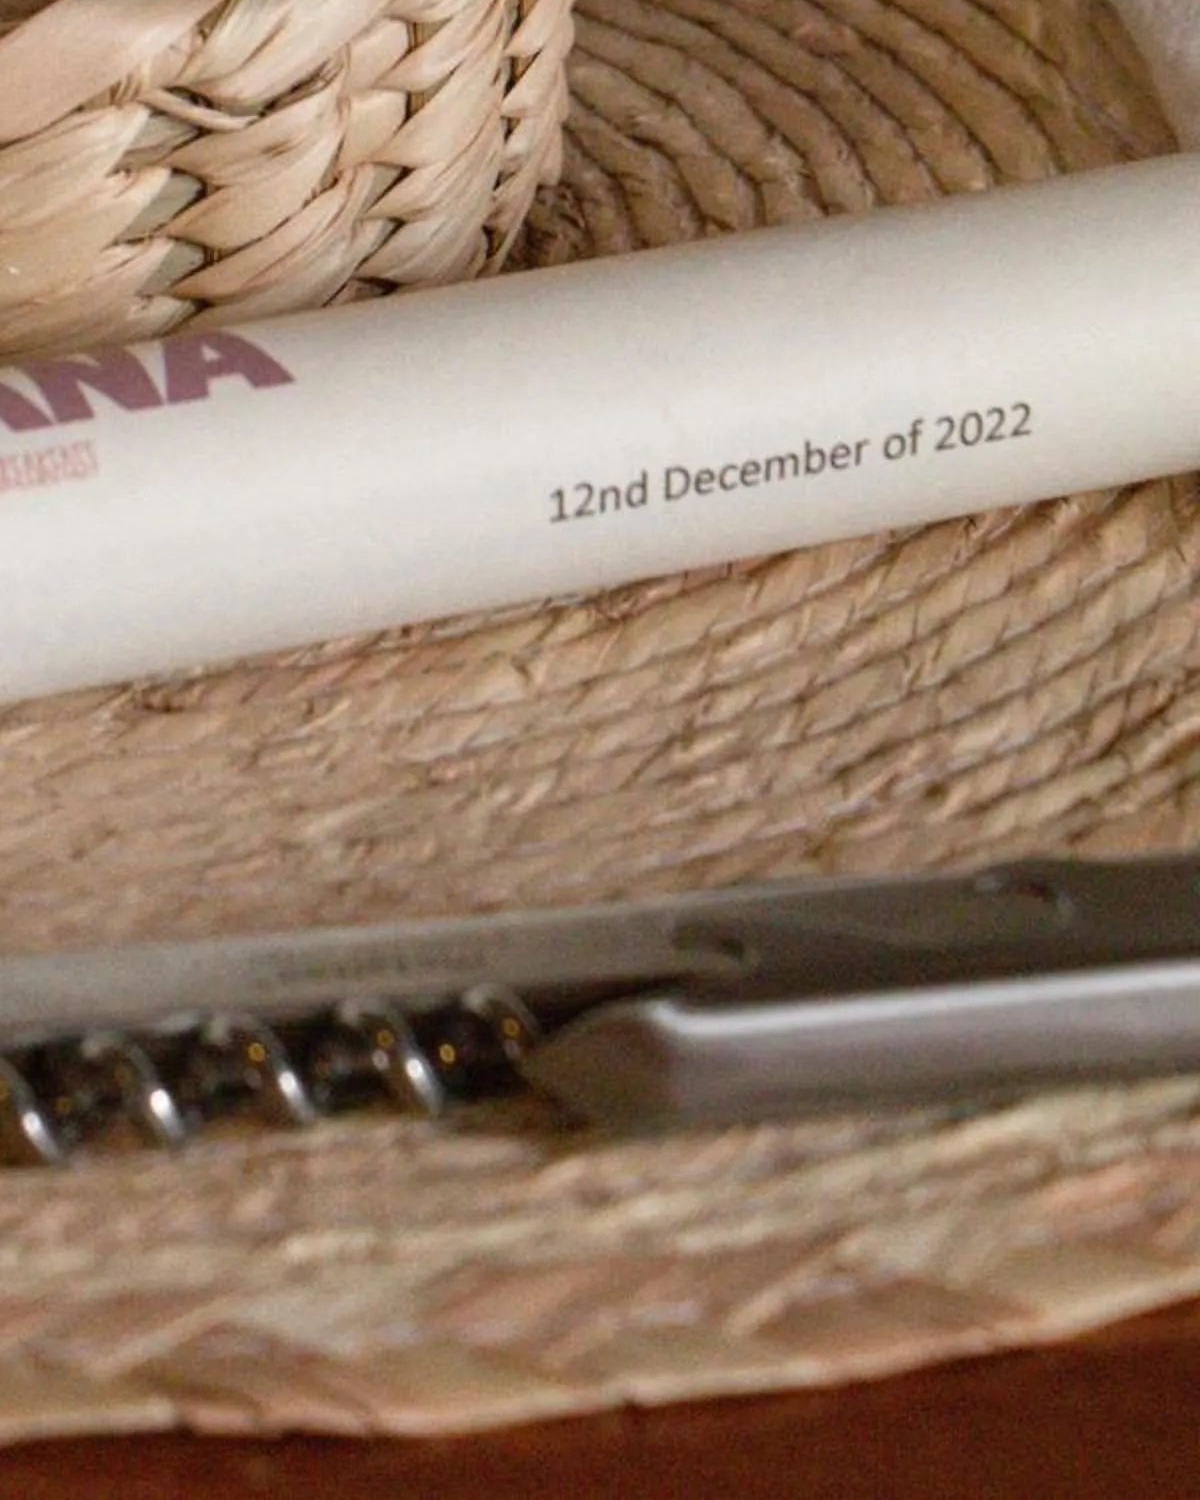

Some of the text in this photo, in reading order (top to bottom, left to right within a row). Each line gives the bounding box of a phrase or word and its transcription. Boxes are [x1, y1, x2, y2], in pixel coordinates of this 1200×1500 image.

[548, 402, 1033, 523] 12nd December of 2022
